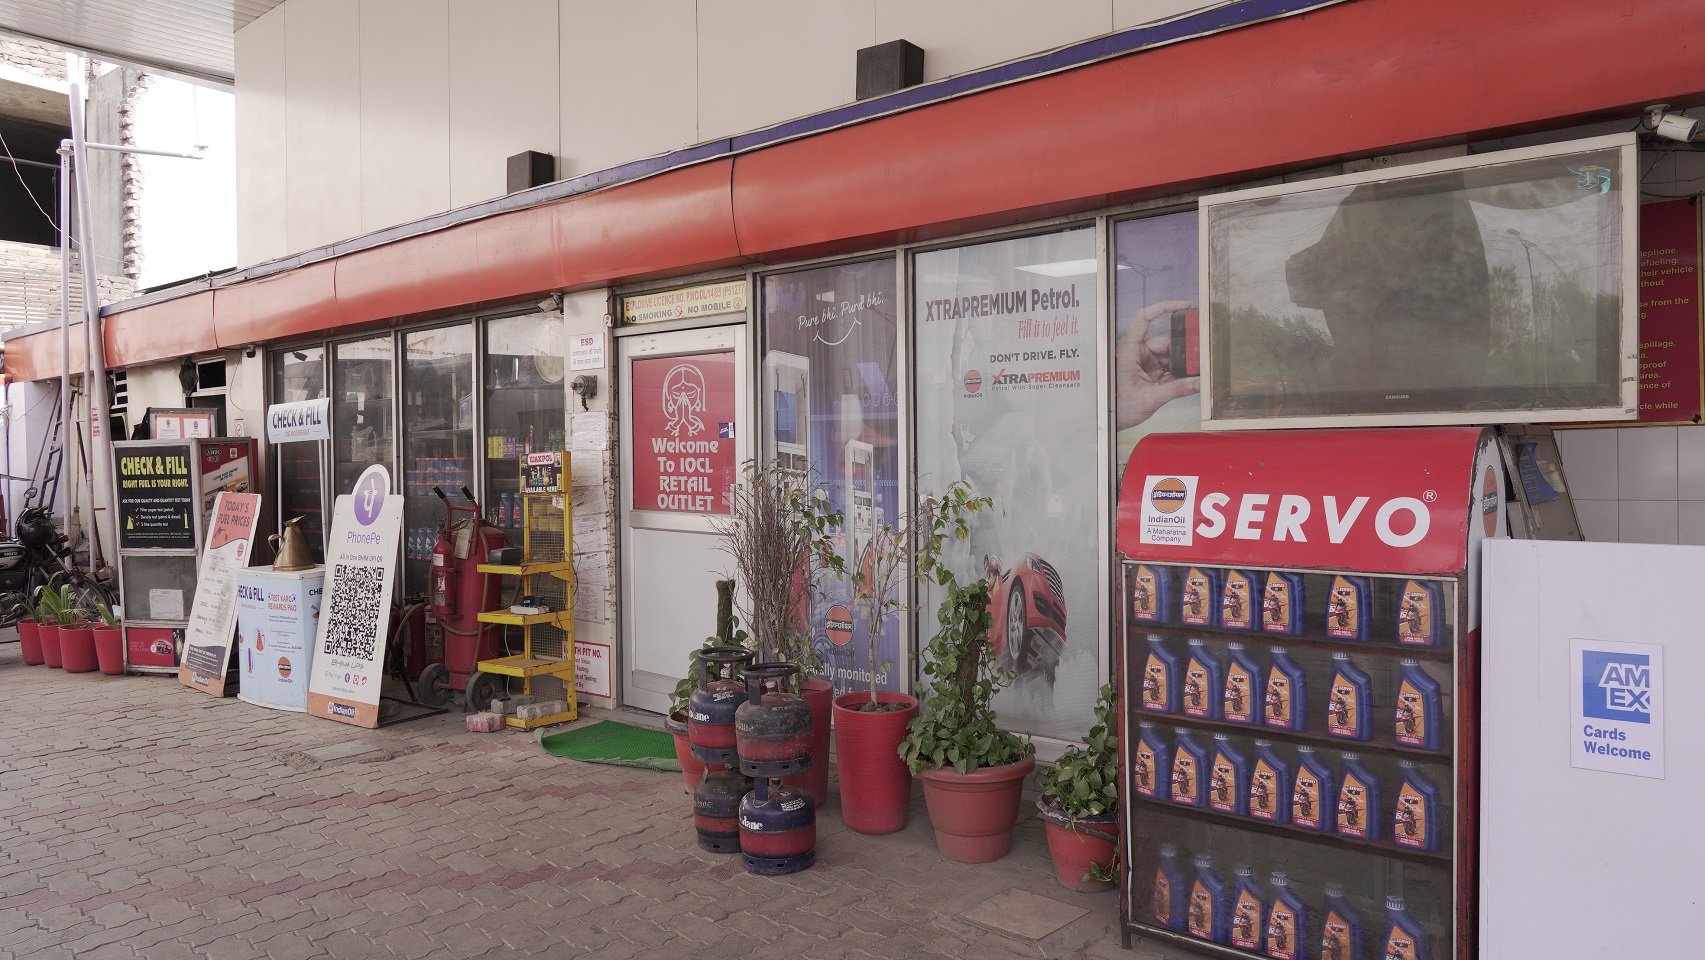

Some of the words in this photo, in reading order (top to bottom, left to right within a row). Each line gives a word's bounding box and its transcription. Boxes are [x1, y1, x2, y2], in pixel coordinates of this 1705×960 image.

[1660, 265, 1693, 275] vehicle
[653, 293, 675, 308] LICENCE
[687, 305, 699, 314] NO
[701, 300, 732, 313] MOBILE
[925, 290, 1027, 322] XTRAPREMIUM
[1031, 283, 1080, 312] Petrol.
[1651, 299, 1672, 307] from
[1674, 297, 1689, 305] the
[626, 315, 637, 323] NO
[638, 309, 673, 322] SMOKING
[798, 315, 820, 330] Pure
[1017, 318, 1033, 340] Fill
[1033, 318, 1041, 338] it
[1041, 319, 1050, 338] to
[1050, 315, 1069, 343] feel
[580, 337, 594, 347] ESD
[989, 352, 1021, 364] DON'T
[1022, 350, 1057, 362] DRIVE.
[1059, 348, 1080, 360] FLY.
[991, 368, 1081, 386] XTRAPREMIUM
[1639, 372, 1661, 380] area.
[1028, 383, 1047, 392] Super
[1048, 382, 1081, 390] Cleansers
[1661, 380, 1671, 389] of
[1654, 401, 1679, 409] while
[272, 409, 297, 430] CHECK
[298, 408, 304, 426] &
[305, 405, 321, 425] FILL
[651, 437, 719, 454] Welcome
[121, 456, 155, 476] CHECK
[155, 455, 165, 475] &
[165, 455, 188, 475] FILL
[656, 456, 676, 473] To
[680, 457, 714, 474] IOCL
[122, 479, 138, 488] RIGHT
[138, 479, 151, 488] FUEL
[151, 479, 157, 488] IS
[157, 479, 171, 488] YOUR
[171, 478, 189, 488] RIGHT.
[659, 475, 713, 494] RETAIL
[224, 500, 249, 513] TODAY'S
[657, 493, 715, 511] OUTLET
[217, 513, 230, 525] FUEL
[230, 514, 251, 527] PRICES
[1147, 515, 1186, 524] IndianOil
[1196, 491, 1430, 548] SERVO
[346, 530, 381, 545] PhonePe
[1151, 535, 1182, 543] Company
[1152, 528, 1187, 536] Maharatna
[253, 587, 264, 601] FILL
[271, 593, 280, 602] TEST
[267, 602, 286, 612] REWARDS
[582, 647, 591, 656] PIT
[592, 648, 602, 658] NO.
[837, 666, 887, 685] monitoed
[1583, 724, 1627, 741] Cards
[1583, 740, 1651, 761] Welcome
